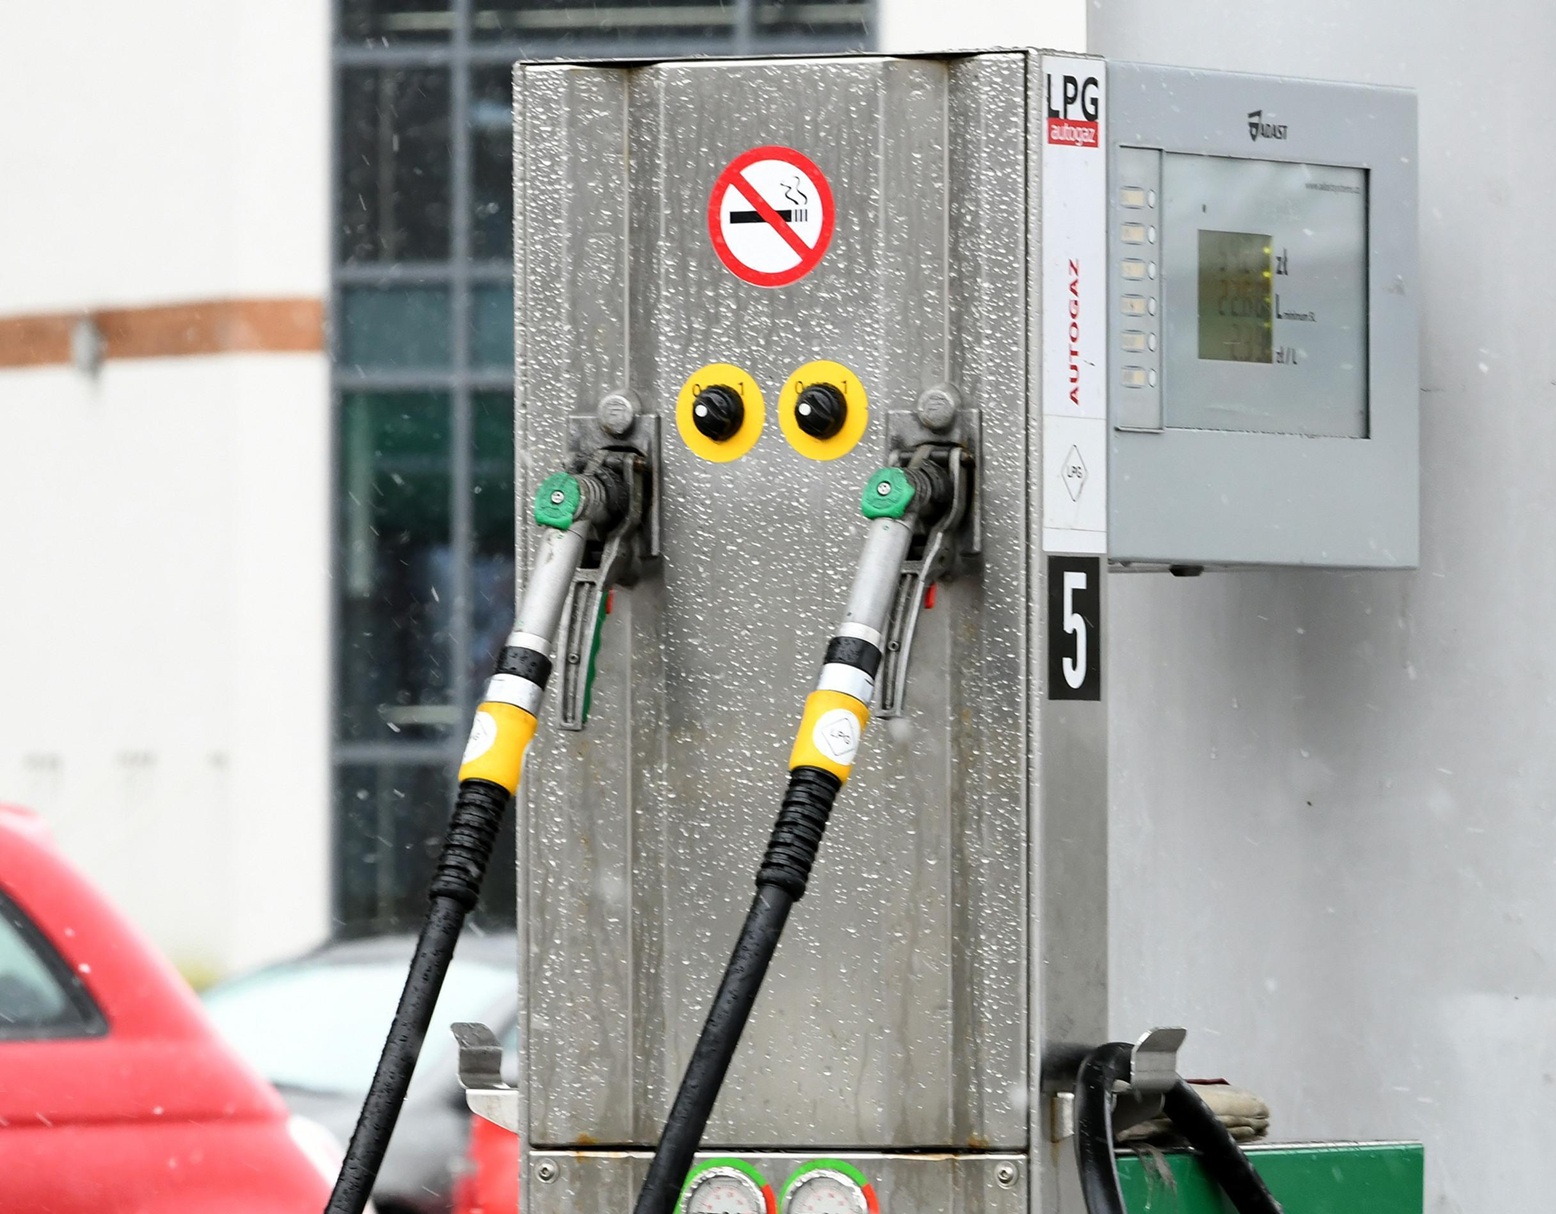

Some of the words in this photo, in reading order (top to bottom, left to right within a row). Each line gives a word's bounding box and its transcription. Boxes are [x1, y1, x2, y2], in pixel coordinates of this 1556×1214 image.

[1047, 73, 1099, 121] LPG
[1050, 123, 1096, 146] autogaz
[1068, 258, 1080, 406] AUTOGAZ
[1066, 465, 1083, 478] LPG
[1062, 571, 1087, 689] 5
